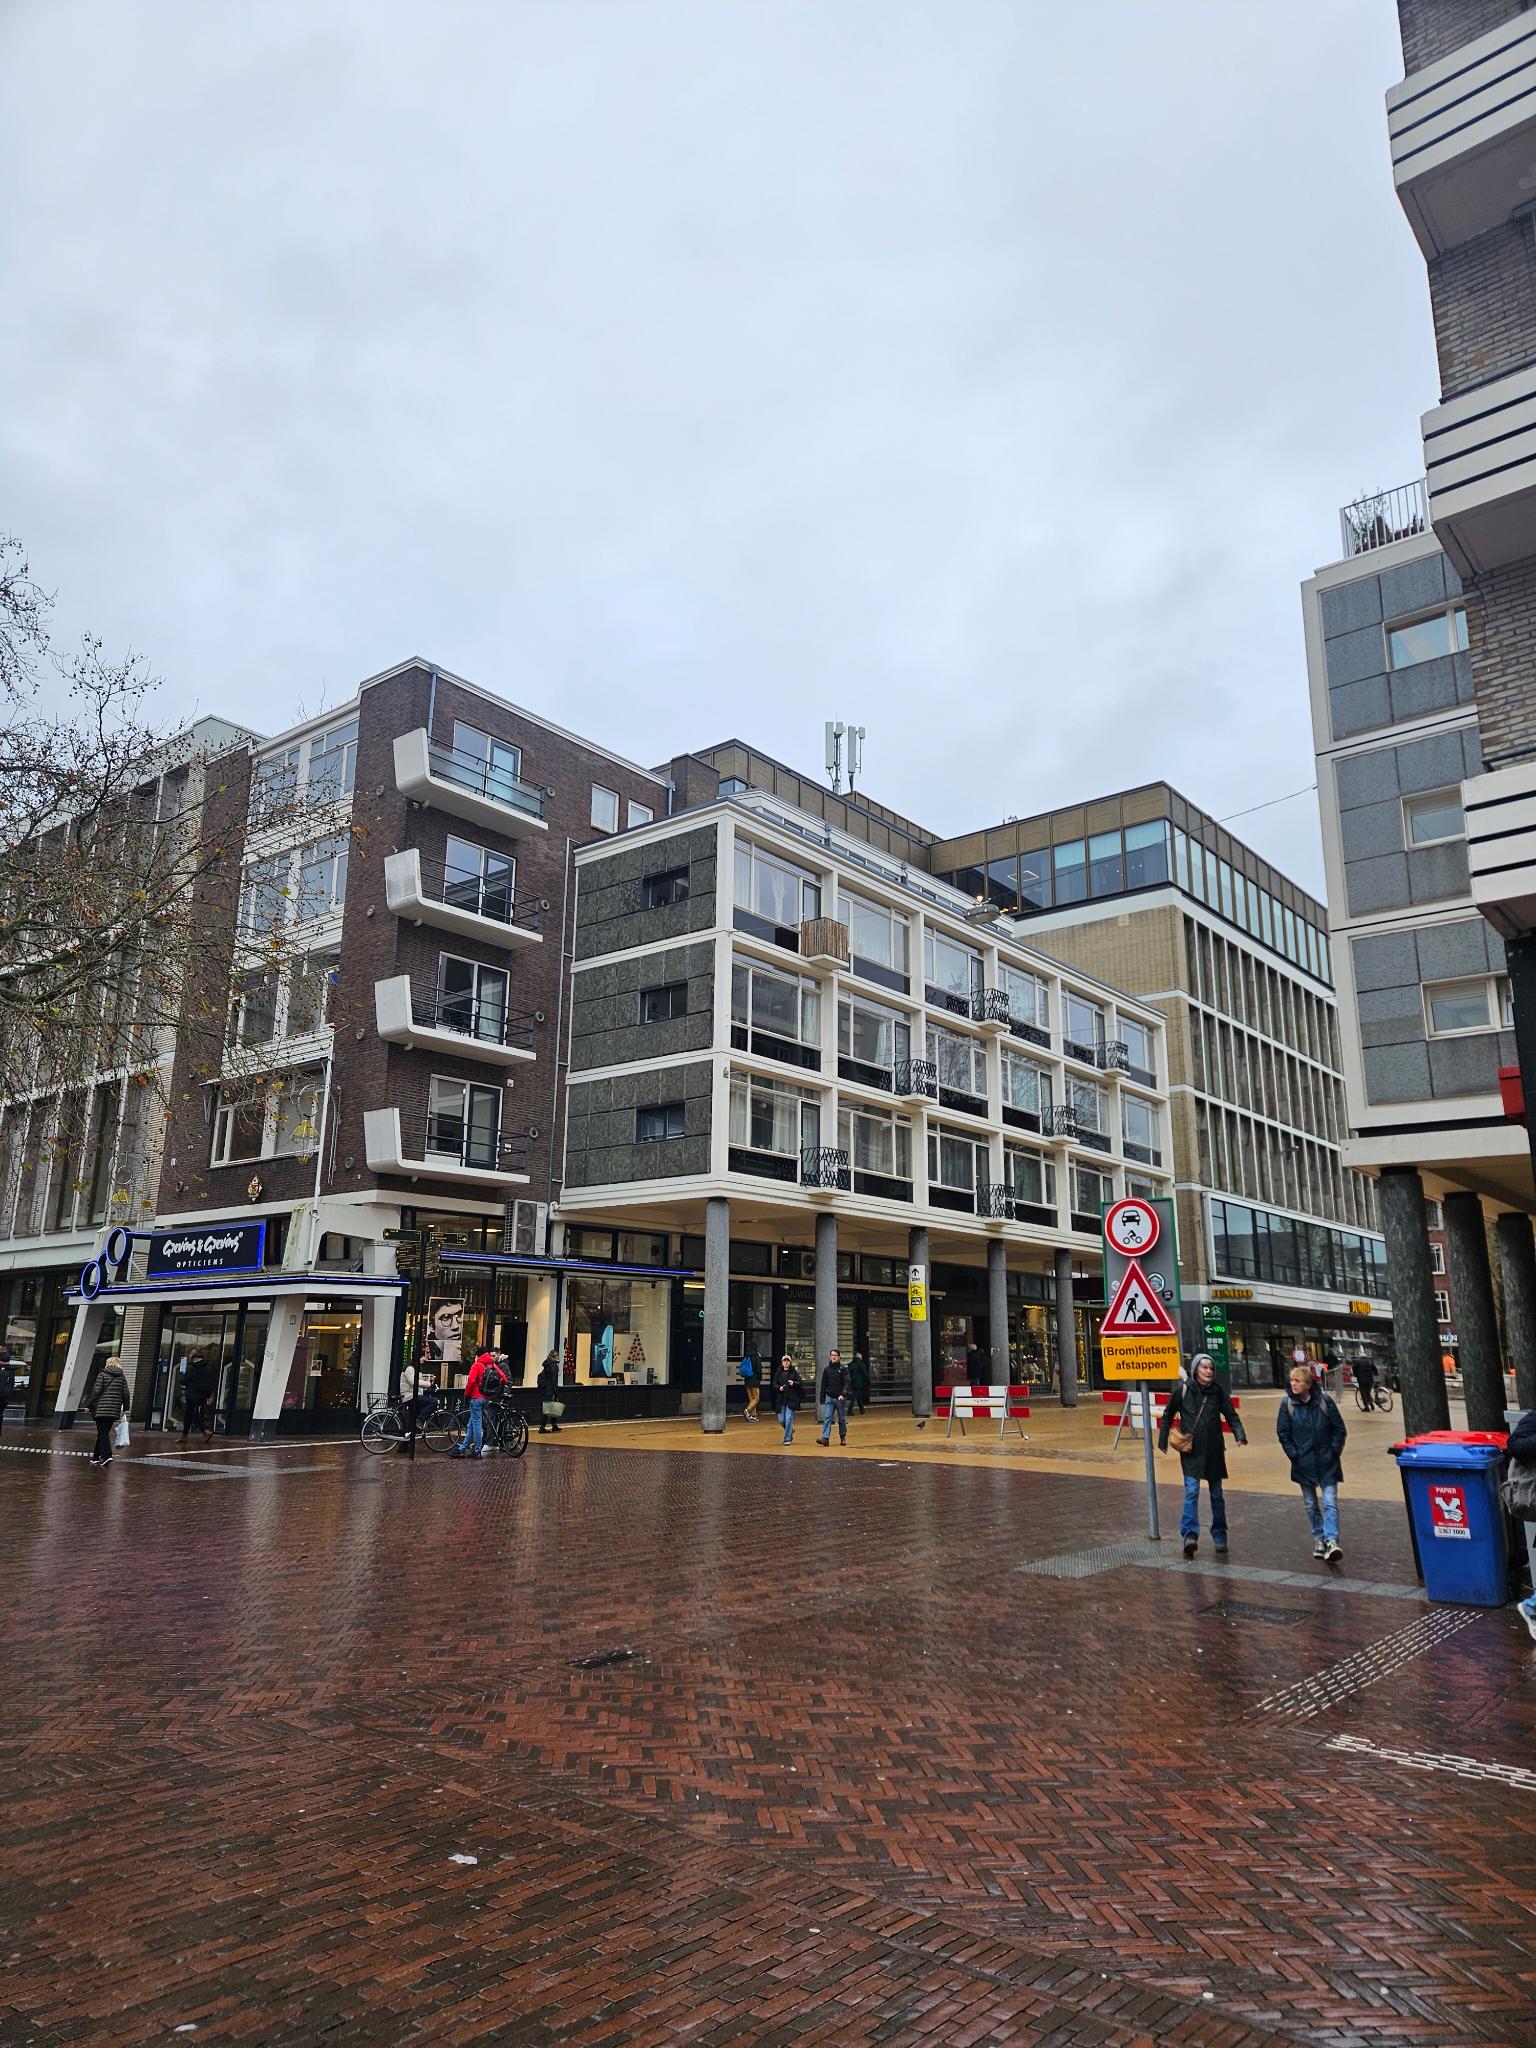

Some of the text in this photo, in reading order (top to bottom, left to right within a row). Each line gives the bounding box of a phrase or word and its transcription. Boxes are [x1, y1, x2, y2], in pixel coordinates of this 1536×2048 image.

[176, 1258, 223, 1268] OPTICIENS
[1203, 1307, 1210, 1316] P
[1103, 1346, 1178, 1357] (Brom)fietsers
[1116, 1360, 1167, 1371] afstappen
